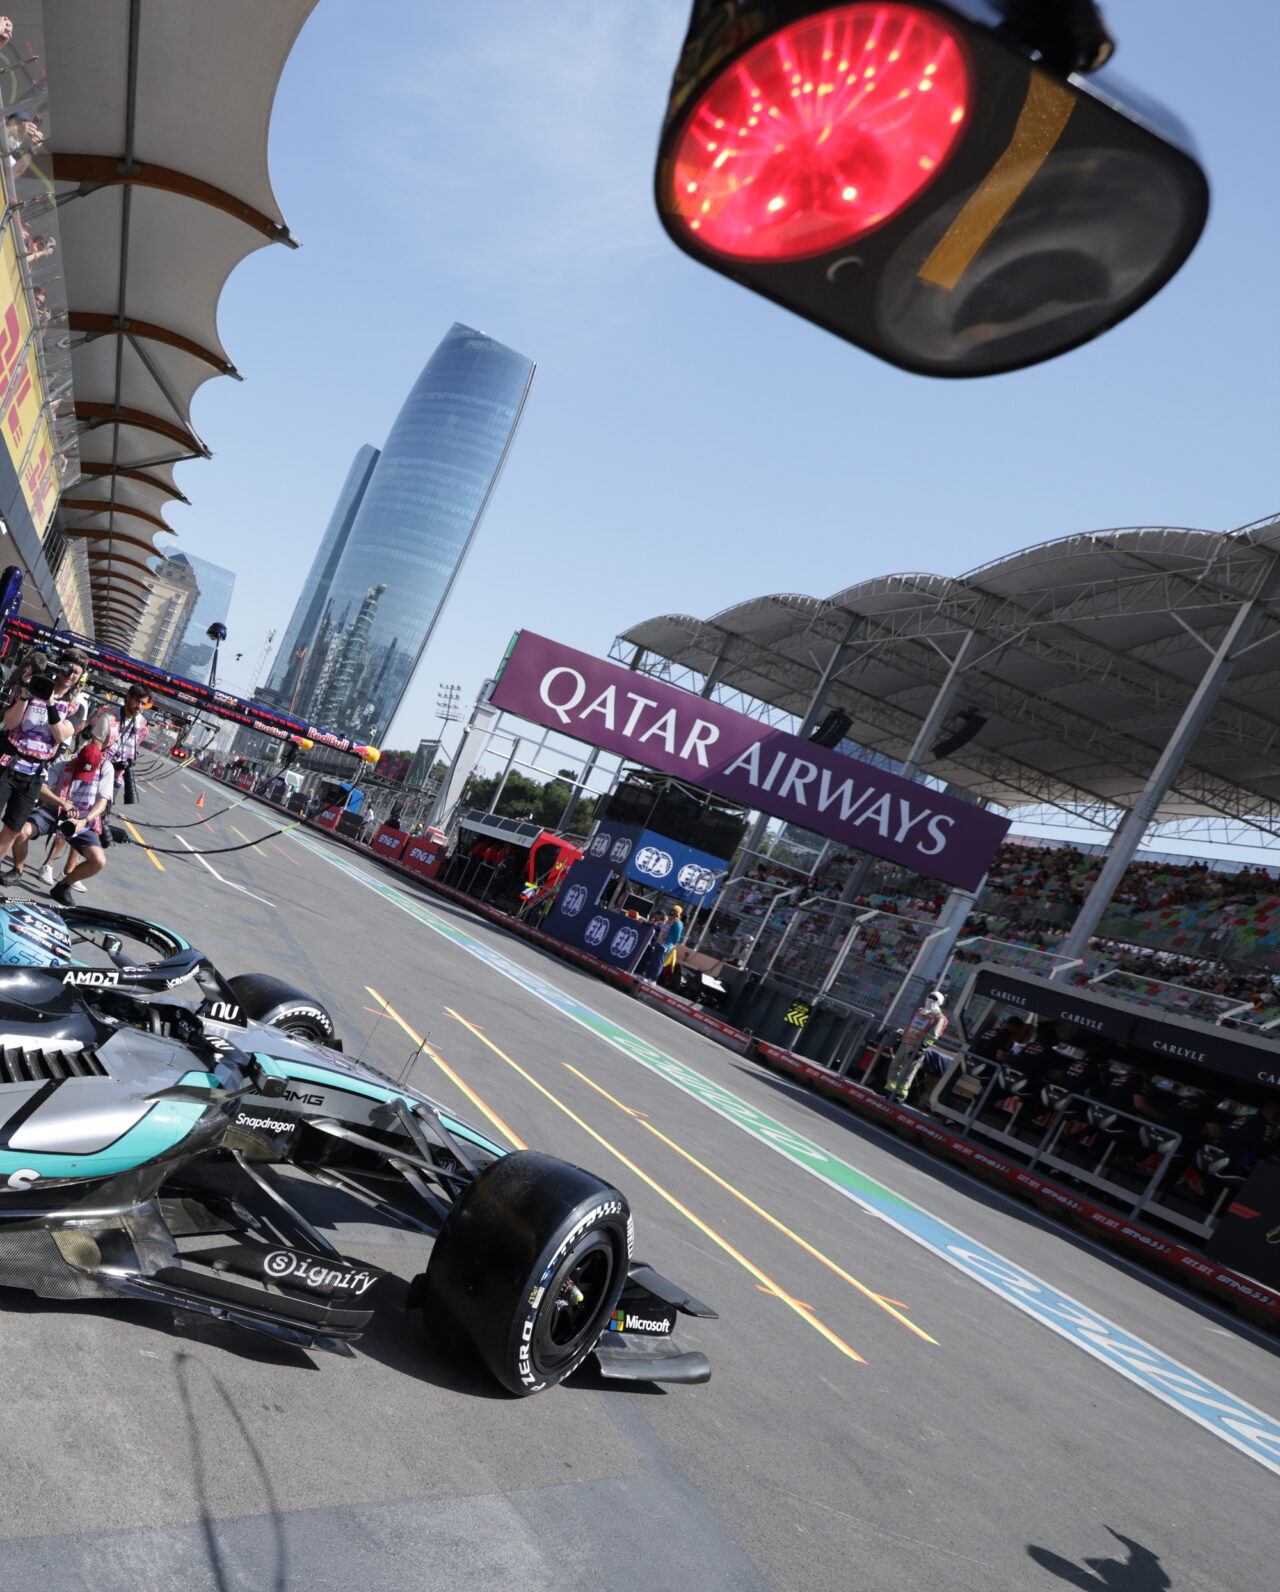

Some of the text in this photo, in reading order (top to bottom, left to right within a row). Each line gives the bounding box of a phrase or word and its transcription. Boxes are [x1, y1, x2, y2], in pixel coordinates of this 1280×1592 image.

[539, 667, 955, 856] QATAR AIRWAYS
[63, 972, 104, 986] AMD
[990, 988, 1027, 1005] CARLYLE
[1061, 1011, 1104, 1030] CARLYLE
[1152, 1040, 1206, 1062] CARLYLE
[236, 1113, 296, 1133] Snapdragon
[625, 1314, 671, 1334] Microsoft
[518, 1320, 536, 1387] ZERO
